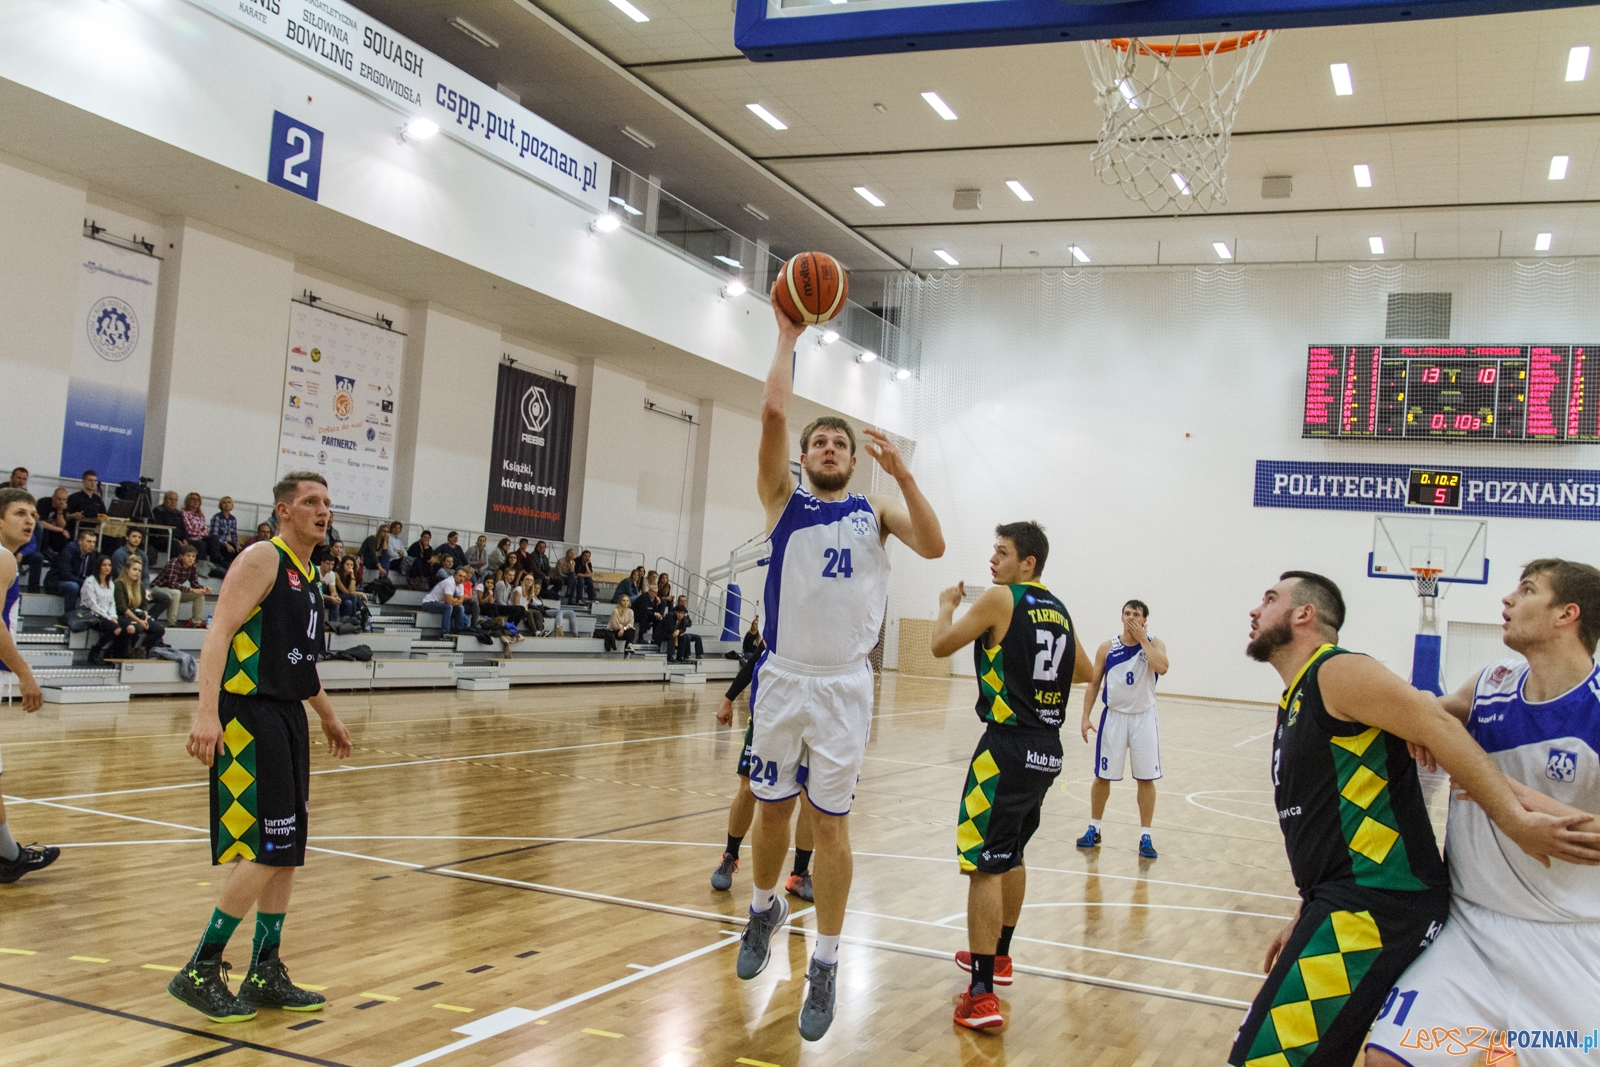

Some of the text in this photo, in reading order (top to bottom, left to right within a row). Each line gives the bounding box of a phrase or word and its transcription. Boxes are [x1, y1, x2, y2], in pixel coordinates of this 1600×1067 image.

[239, 2, 267, 24] KARATE
[302, 9, 349, 45] SIŁOWNIA
[286, 18, 353, 71] BOWLING
[363, 26, 424, 78] SQUASH
[360, 62, 422, 107] ERGOWIOSŁA
[436, 83, 597, 192] cspp.put.poznan.pl
[283, 127, 311, 188] 2
[1422, 368, 1440, 382] 13
[1477, 368, 1496, 384] 10
[321, 435, 357, 451] PARTNERZY:
[521, 432, 545, 447] REBIS
[503, 459, 533, 477] Książki,
[501, 477, 556, 497] które się czyta
[1273, 473, 1600, 506] POLITECHN POZNAŃS
[1420, 473, 1458, 487] 0.10.2
[1434, 488, 1447, 503] 5
[492, 502, 560, 522] www.rebis.com.pl
[822, 548, 853, 578] 24
[306, 608, 318, 640] 11
[1032, 628, 1067, 682] 21
[1125, 671, 1135, 686] 8
[1026, 750, 1048, 766] klub
[1101, 757, 1108, 771] 8
[750, 755, 778, 786] 24
